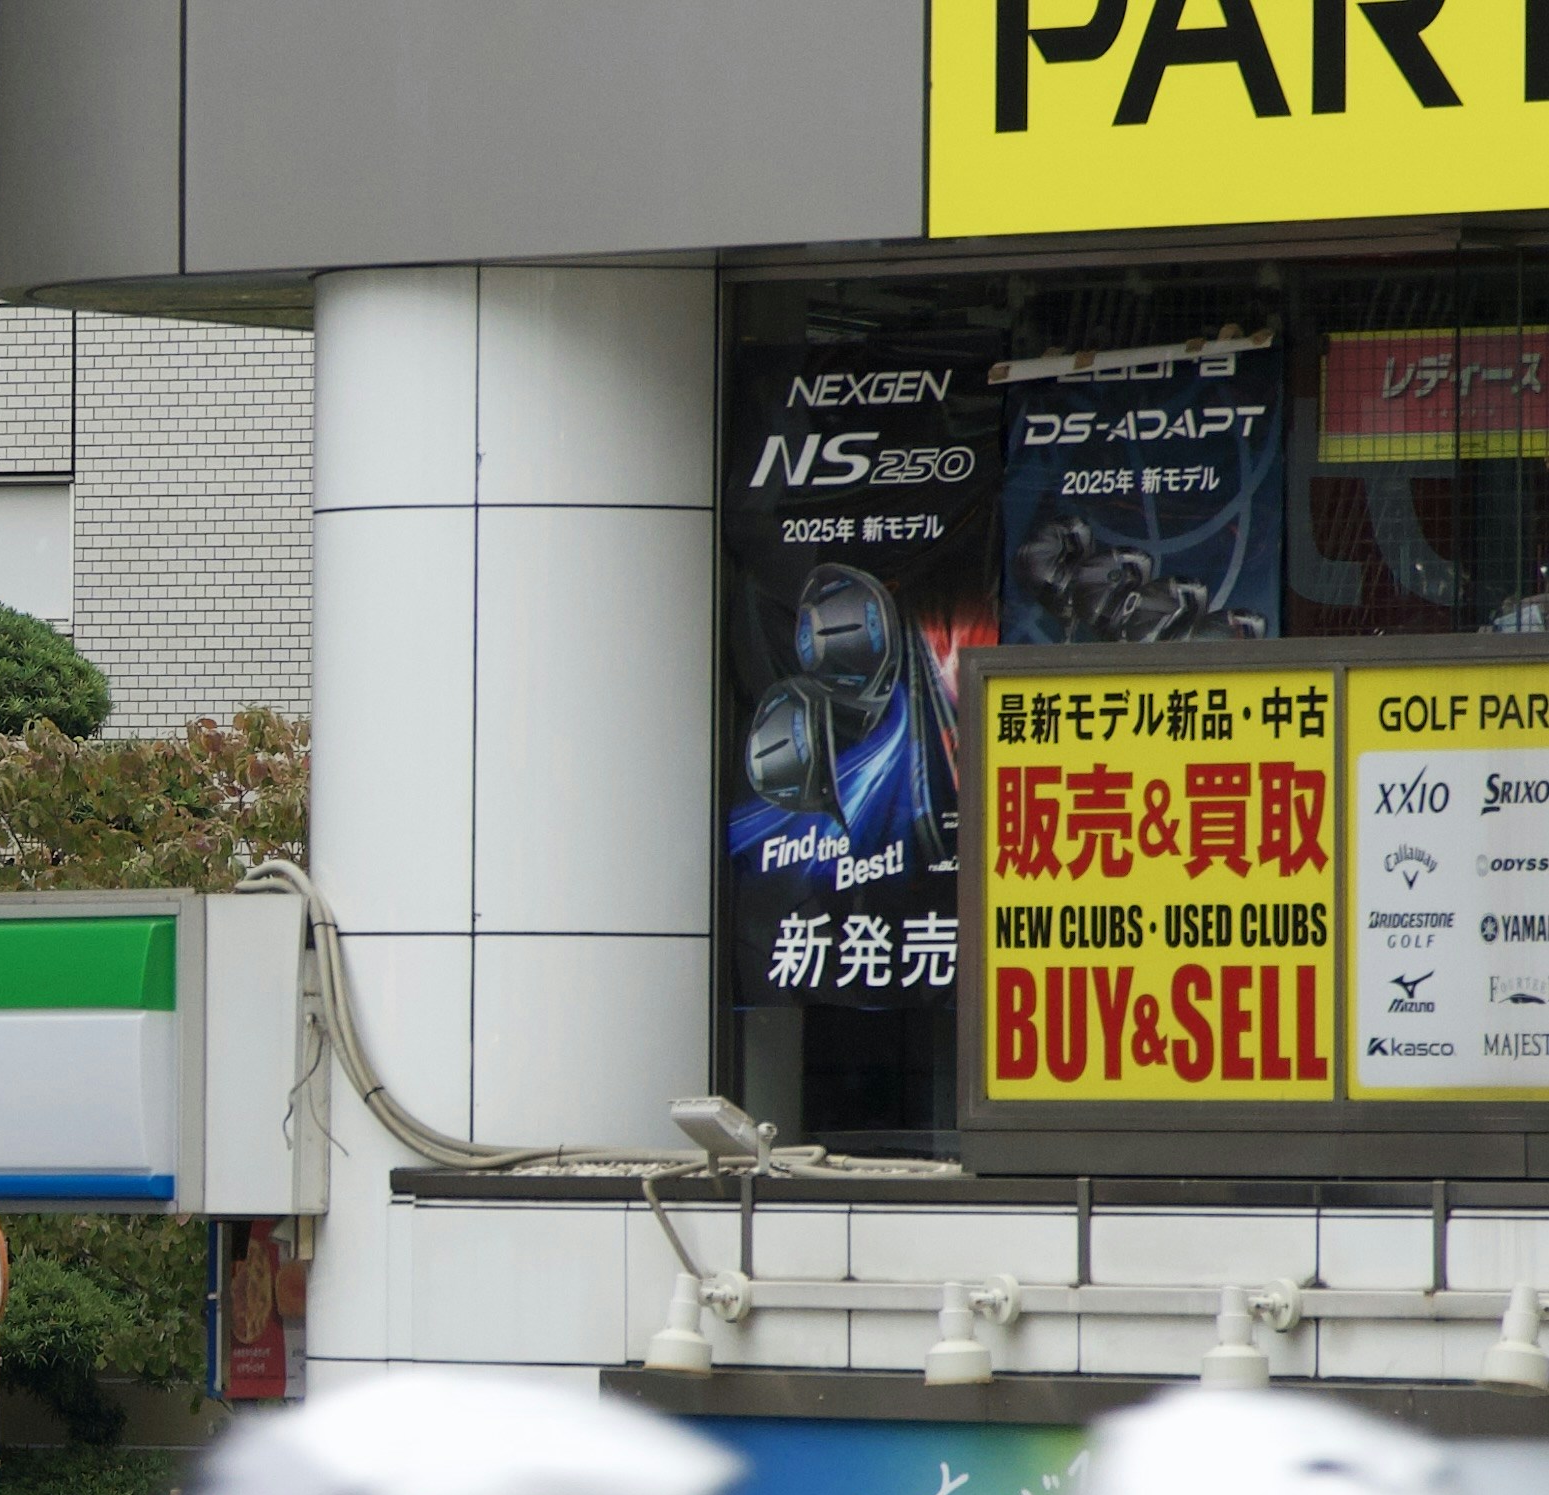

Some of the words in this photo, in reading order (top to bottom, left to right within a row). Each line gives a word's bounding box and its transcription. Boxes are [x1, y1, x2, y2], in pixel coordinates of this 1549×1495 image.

[995, 0, 1549, 133] PAR
[786, 369, 953, 408] NEXGEN
[1024, 405, 1266, 446] DS-ADAPT
[1062, 468, 1134, 496] 2025年
[1141, 465, 1220, 494] 新モデル
[782, 516, 855, 544] 2025年
[862, 514, 945, 542] 新モデル
[996, 686, 1329, 745] 最新モデル新品・中古
[1378, 695, 1469, 732] GOLF
[994, 761, 1329, 880] 販売&買取
[761, 825, 817, 872] Find
[817, 833, 850, 862] the
[836, 840, 904, 891] Best!
[996, 905, 1052, 948] NEW
[1060, 905, 1143, 948] CLUBS
[1165, 904, 1232, 948] USED
[1241, 902, 1327, 947] CLUBS
[1368, 911, 1455, 929] BRIDGESTONE
[1387, 934, 1436, 948] GOLF
[1501, 915, 1549, 942] YAMA
[768, 911, 960, 988] 新発売
[996, 963, 1328, 1083] BUY&SELL
